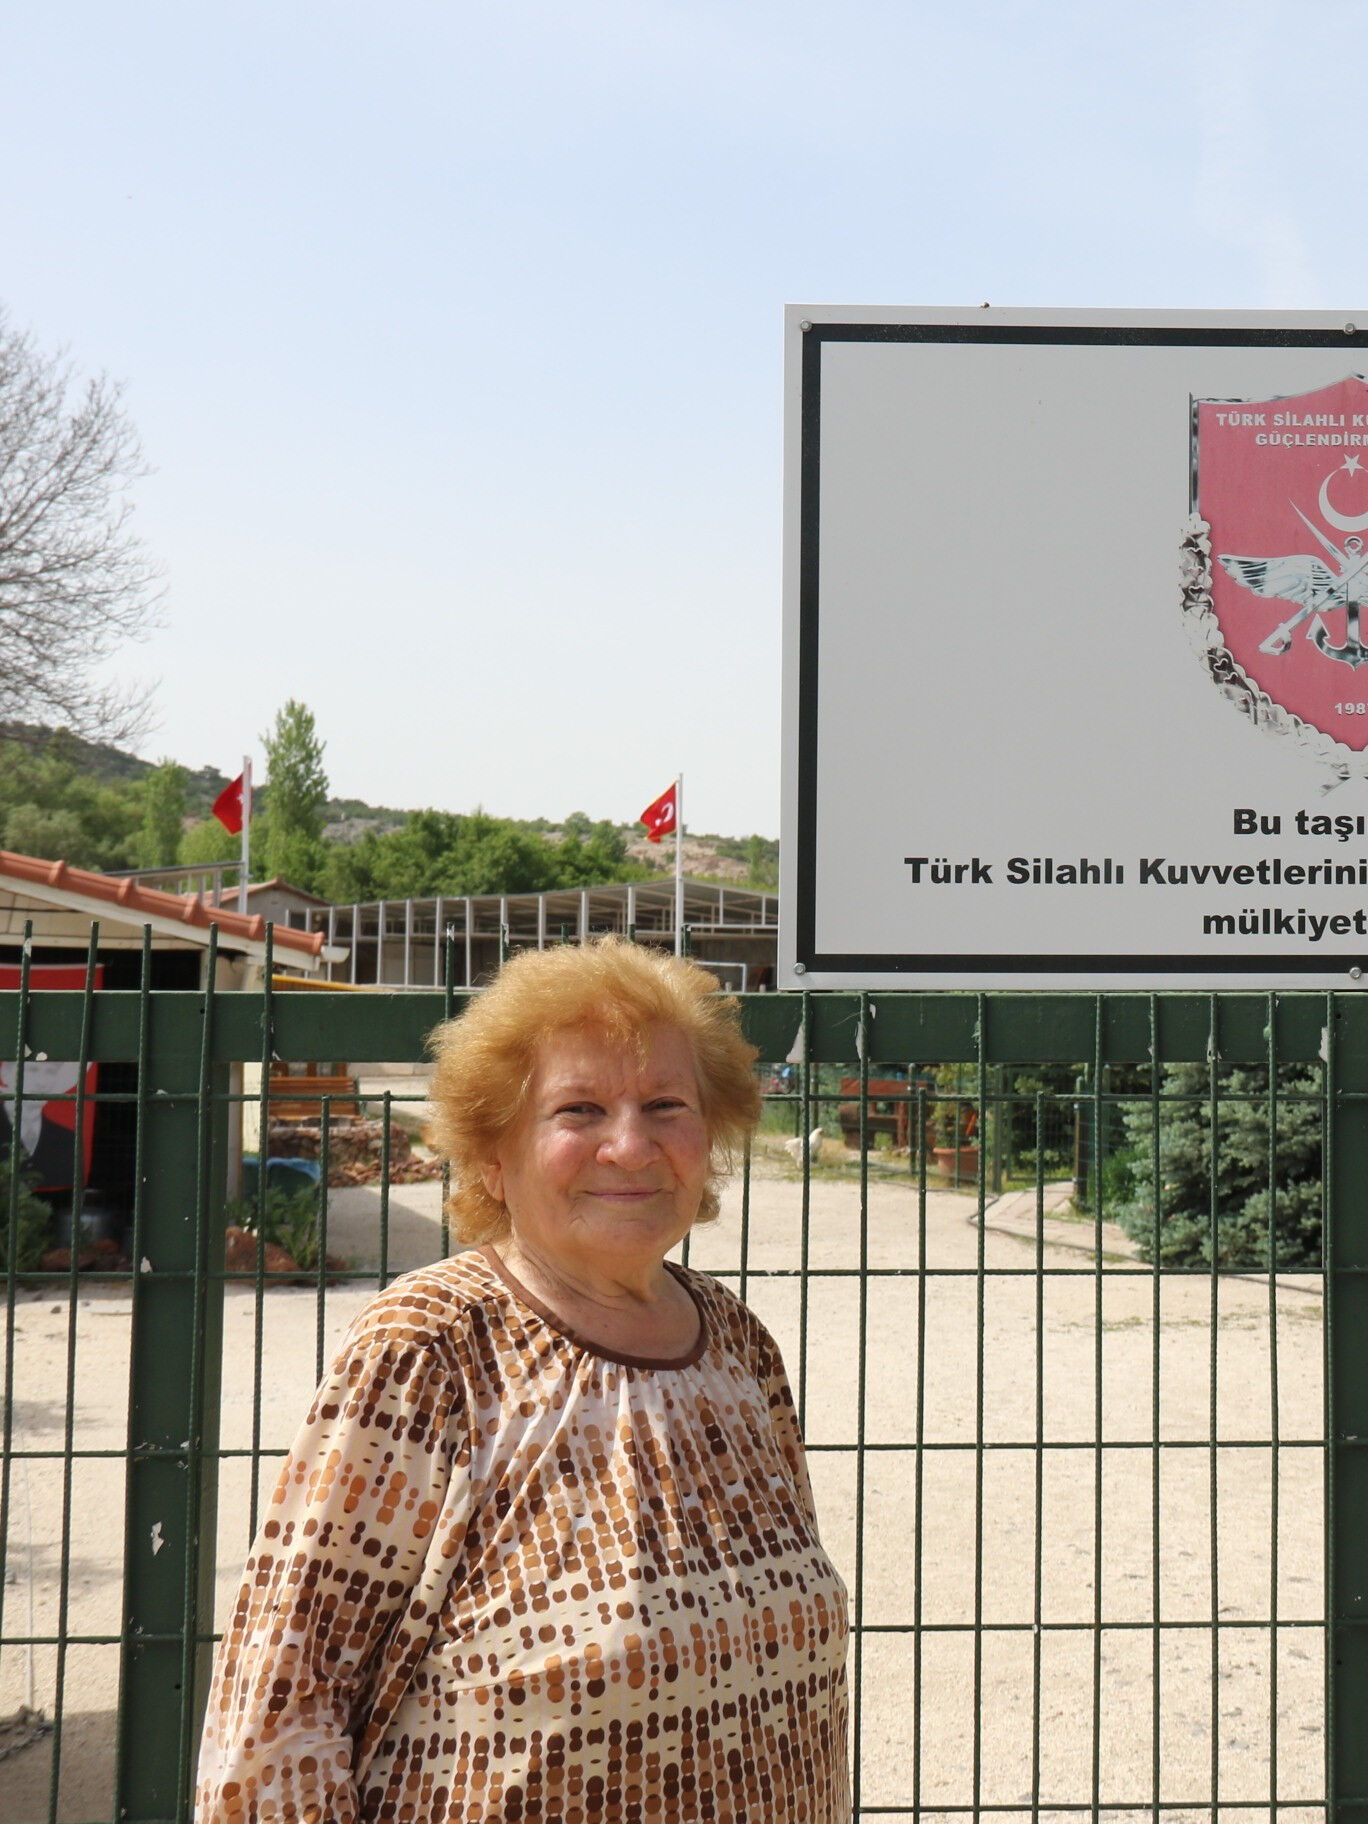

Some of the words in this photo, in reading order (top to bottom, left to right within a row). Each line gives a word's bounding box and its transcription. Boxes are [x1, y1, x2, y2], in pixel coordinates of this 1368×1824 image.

[1216, 410, 1266, 426] TÜRK
[1273, 410, 1345, 427] SİLAHLI
[1233, 808, 1281, 836] Bu
[904, 857, 993, 884] Türk
[1006, 857, 1124, 885] Silahlı
[1139, 858, 1368, 885] Kuvvetlerini
